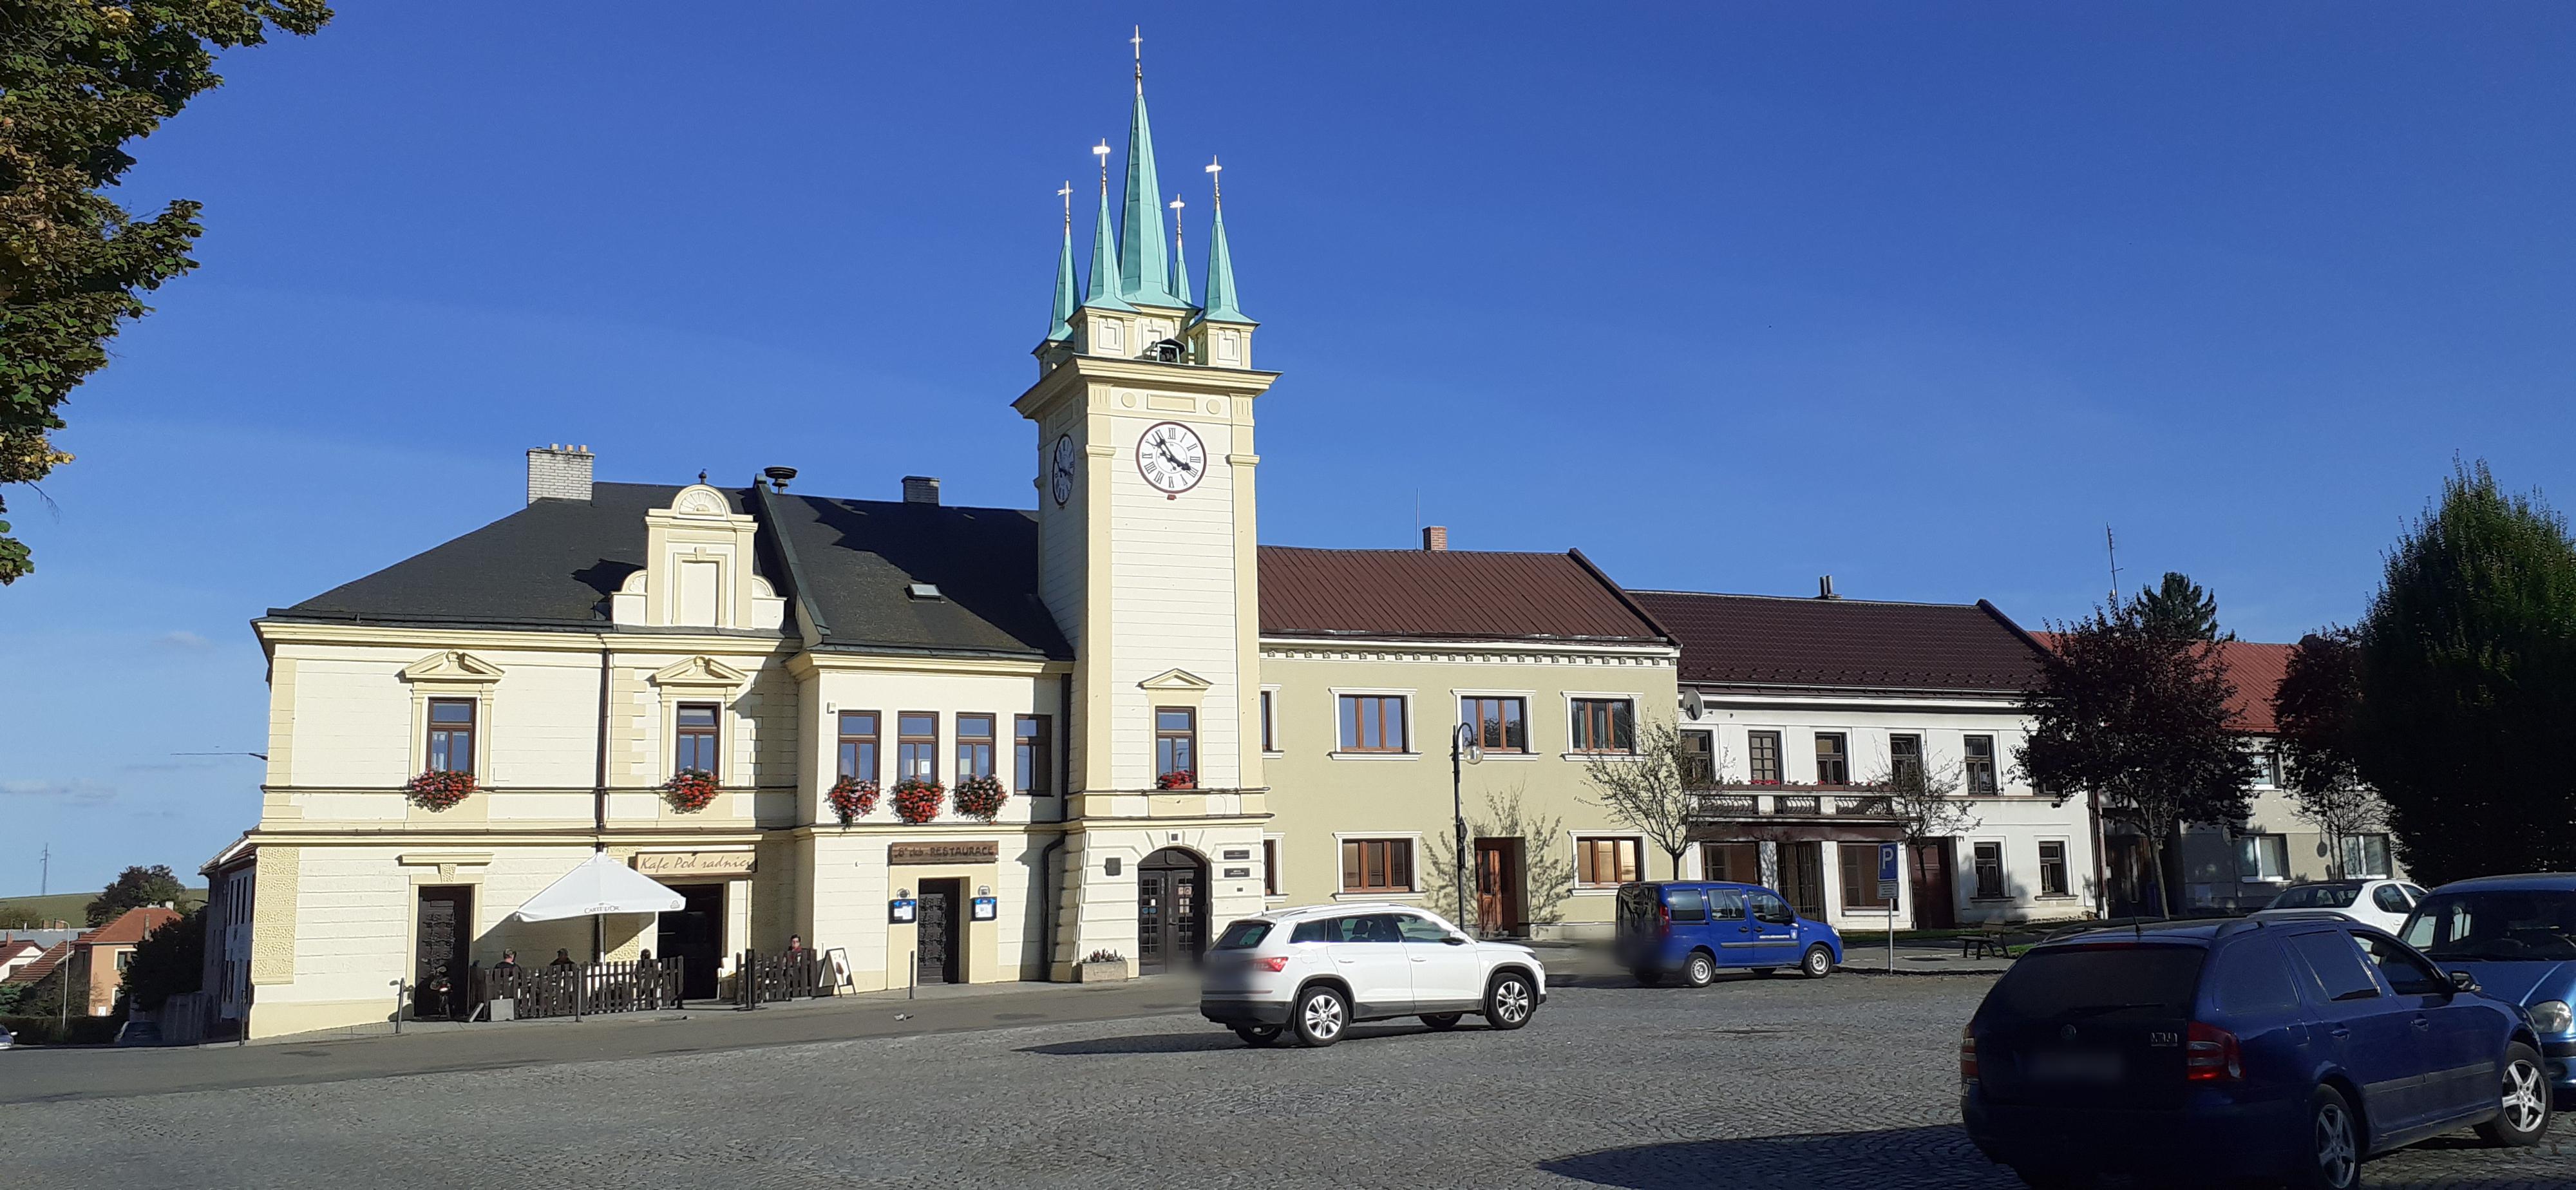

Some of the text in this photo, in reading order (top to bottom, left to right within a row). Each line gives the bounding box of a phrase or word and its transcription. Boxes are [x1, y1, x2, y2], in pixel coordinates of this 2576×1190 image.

[930, 846, 994, 856] RESTAURACE
[1882, 847, 1893, 869] P
[640, 856, 668, 873] Kafe
[674, 855, 697, 869] Pod
